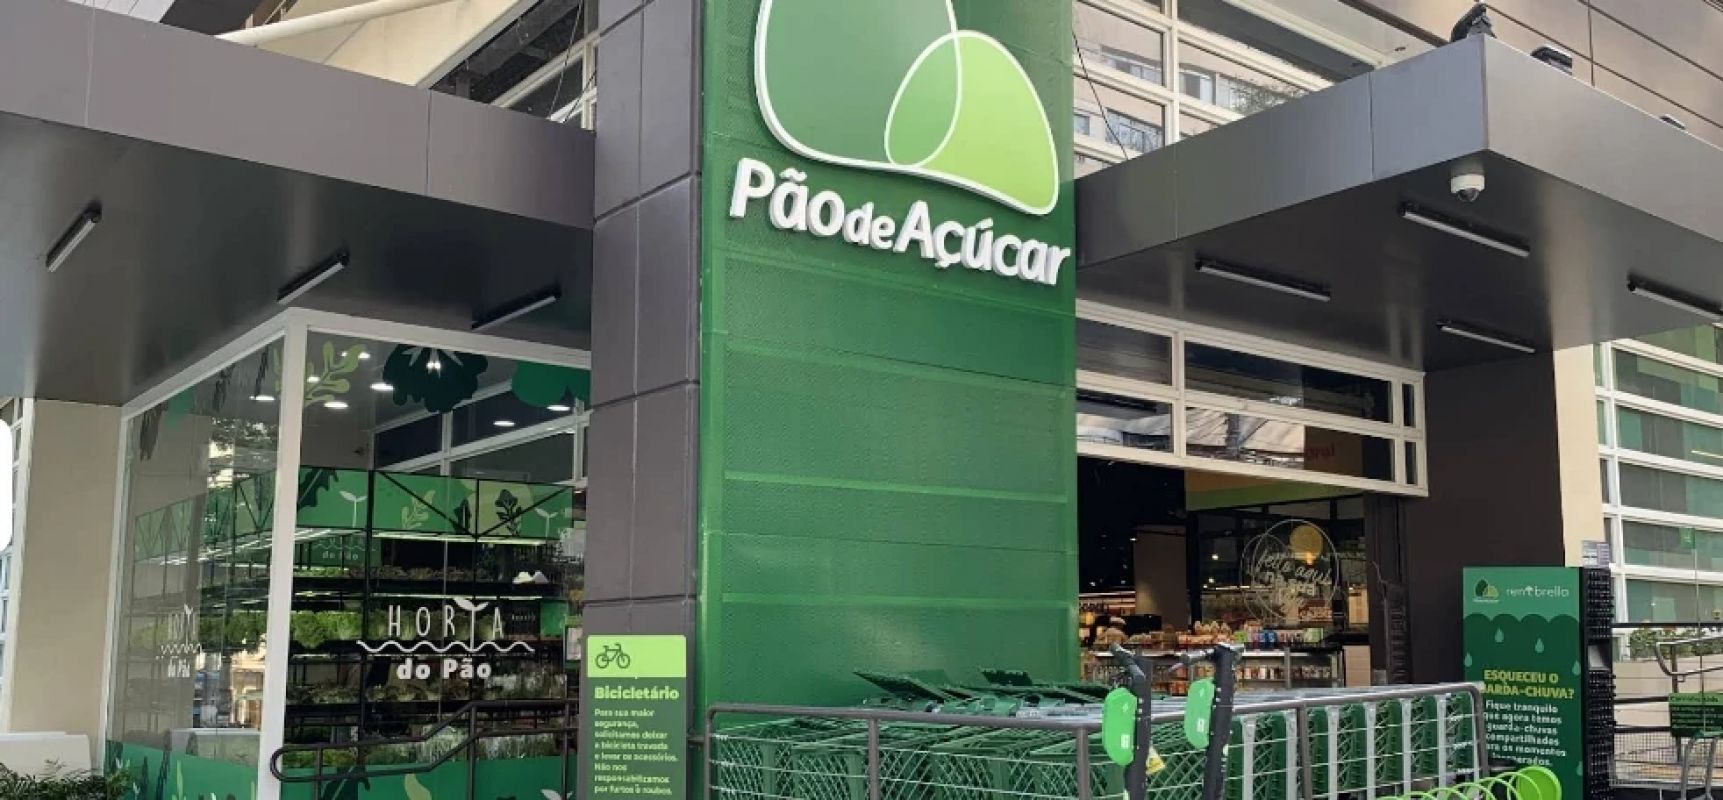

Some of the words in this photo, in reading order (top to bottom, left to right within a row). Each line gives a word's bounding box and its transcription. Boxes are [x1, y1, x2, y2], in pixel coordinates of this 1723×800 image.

[729, 157, 845, 238] Pão
[842, 202, 896, 250] de
[892, 199, 1071, 286] Açúcar
[387, 597, 506, 645] HORTA
[397, 658, 431, 680] do
[443, 657, 492, 680] Pão
[1483, 669, 1547, 684] ESQUECEU
[1548, 673, 1559, 684] O
[594, 685, 680, 700] Bicicletário
[1480, 682, 1575, 699] ARDA-CHUVA?
[594, 708, 613, 717] Para
[614, 709, 629, 717] sua
[630, 708, 655, 717] maior
[1485, 699, 1512, 712] Fique
[1513, 702, 1559, 716] tranquilo
[1501, 713, 1530, 724] agora
[1530, 713, 1563, 725] temos
[594, 762, 611, 771] Não
